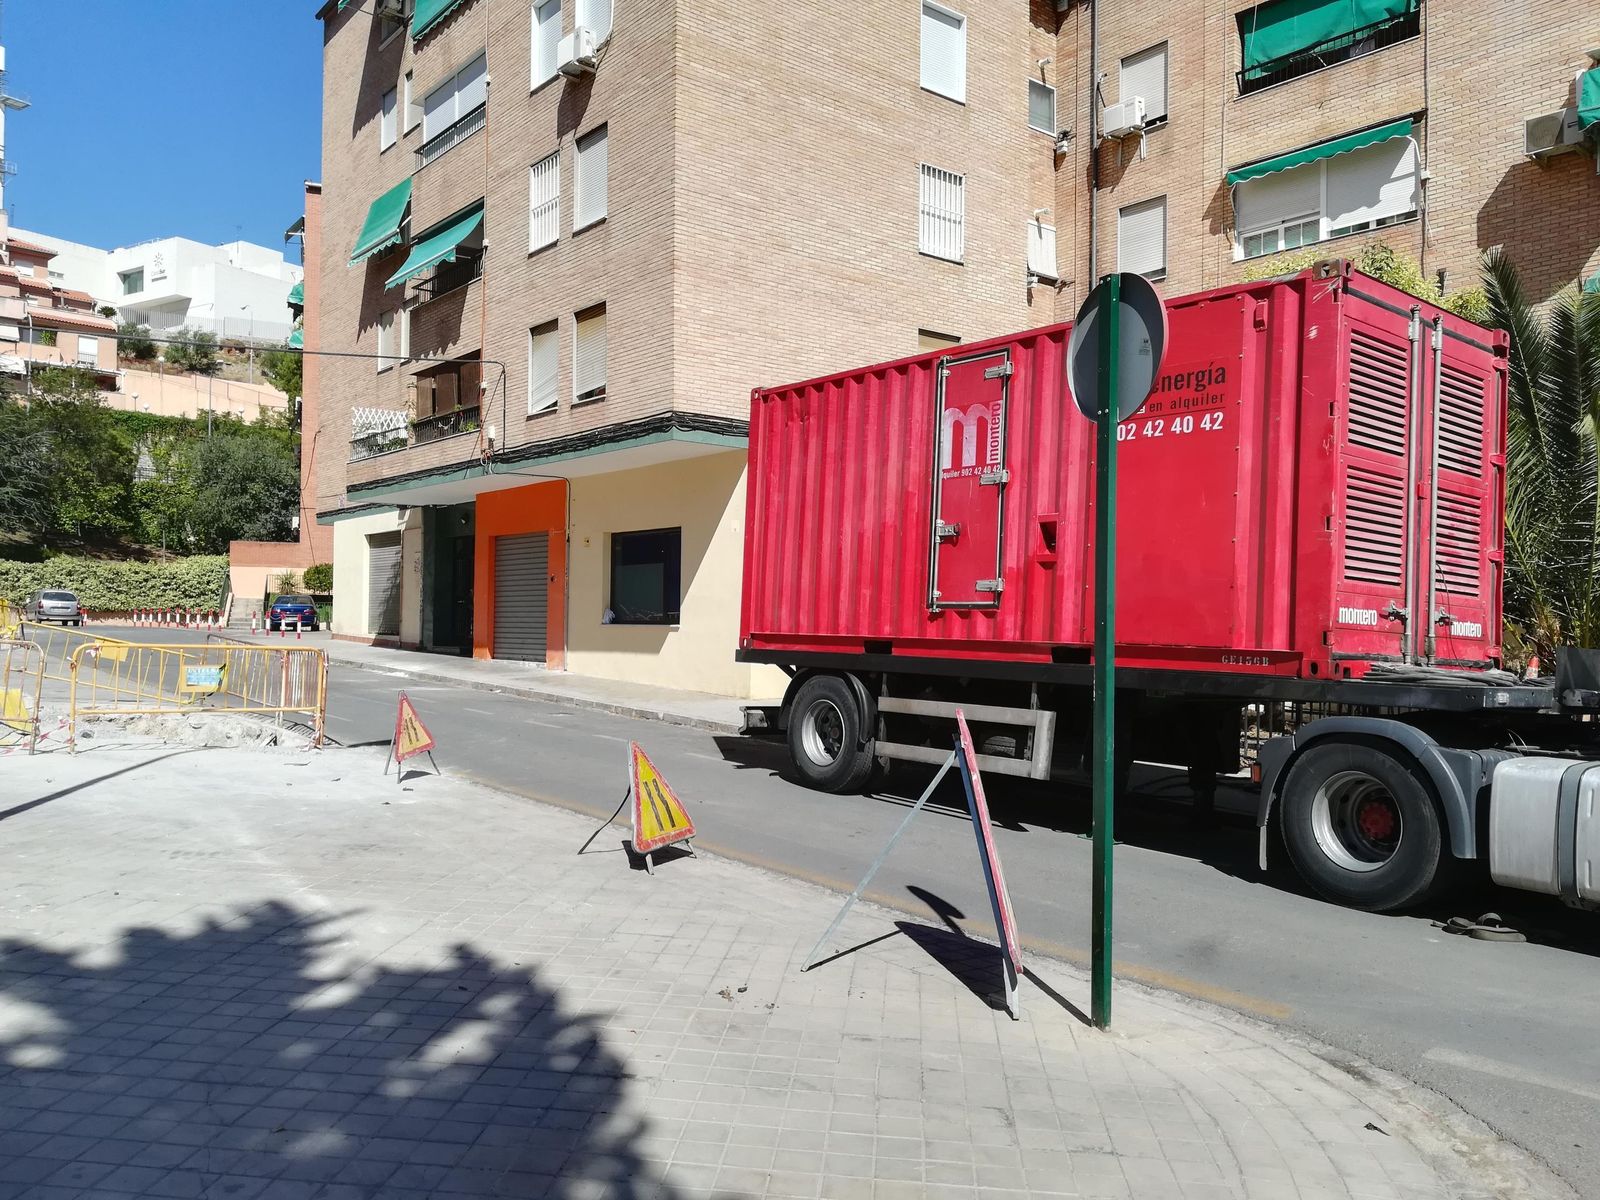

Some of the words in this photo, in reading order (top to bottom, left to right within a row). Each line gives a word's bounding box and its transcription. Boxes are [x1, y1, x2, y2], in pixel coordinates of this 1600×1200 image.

[1149, 401, 1163, 413] en
[1170, 393, 1225, 410] alquiler
[989, 403, 1001, 462] montero
[1116, 423, 1137, 442] 02
[1143, 419, 1164, 438] 42
[1171, 415, 1194, 435] 40
[1201, 411, 1224, 431] 42
[974, 466, 982, 475] 42
[1338, 606, 1377, 626] montero
[1450, 621, 1482, 638] montero
